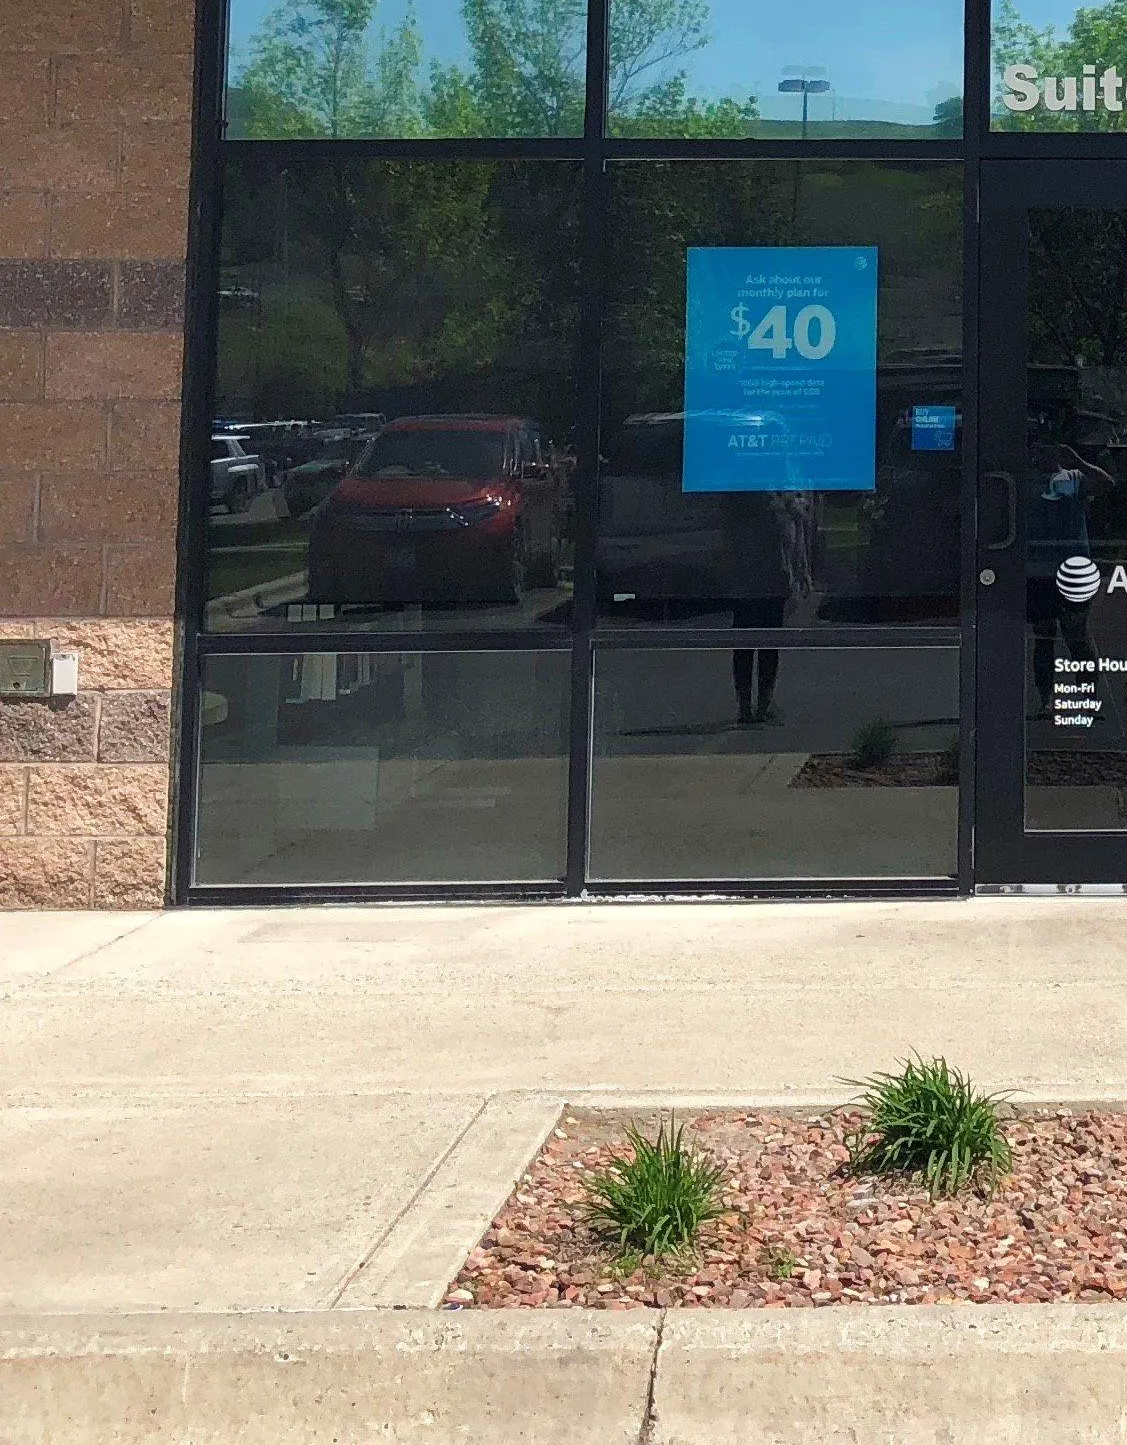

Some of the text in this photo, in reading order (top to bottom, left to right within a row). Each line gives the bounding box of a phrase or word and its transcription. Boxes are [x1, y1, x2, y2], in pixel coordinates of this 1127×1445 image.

[745, 274, 823, 285] Ask about our
[737, 287, 830, 299] monthly plan for
[730, 301, 836, 360] $40
[727, 434, 769, 448] AT&T
[1054, 658, 1095, 672] Store
[1054, 682, 1095, 694] Mon-Fri
[1054, 699, 1102, 712] Saturday
[1054, 715, 1094, 727] Sunday
